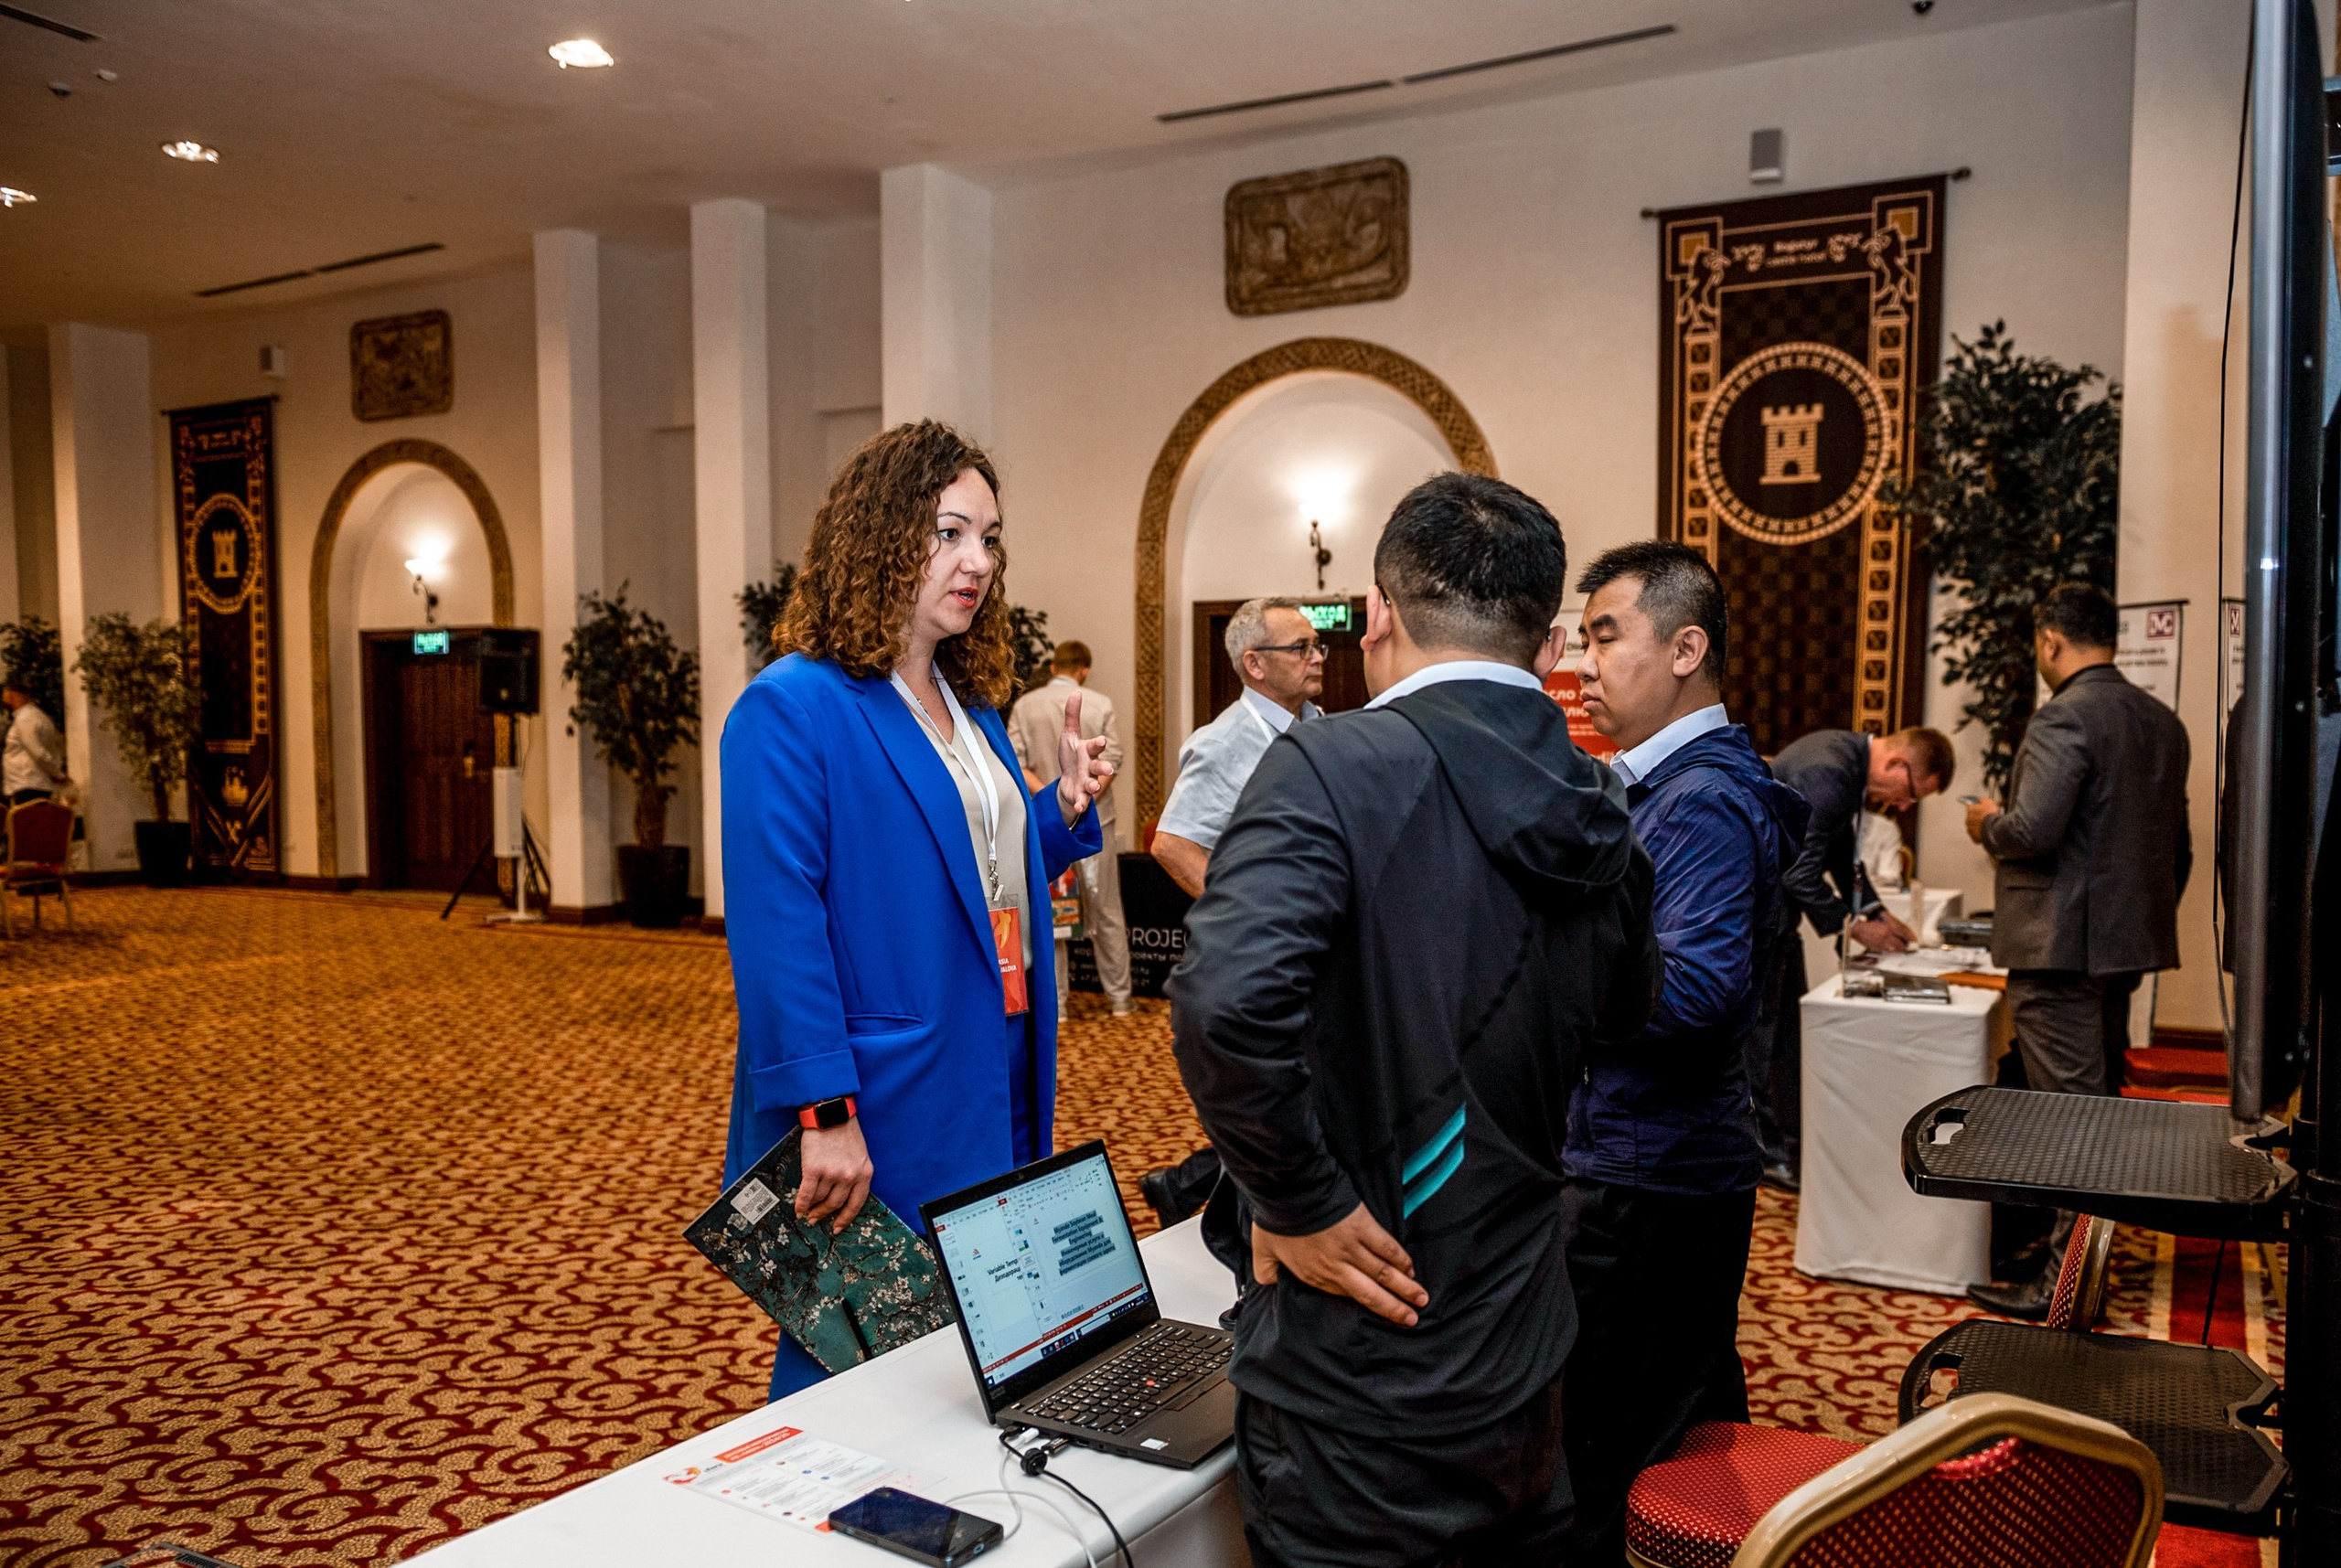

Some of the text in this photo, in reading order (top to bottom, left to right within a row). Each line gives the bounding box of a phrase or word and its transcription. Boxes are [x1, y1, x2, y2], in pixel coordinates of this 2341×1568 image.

[1545, 689, 1577, 701] сло
[1127, 927, 1188, 948] ROJE
[1129, 952, 1167, 962] роекты
